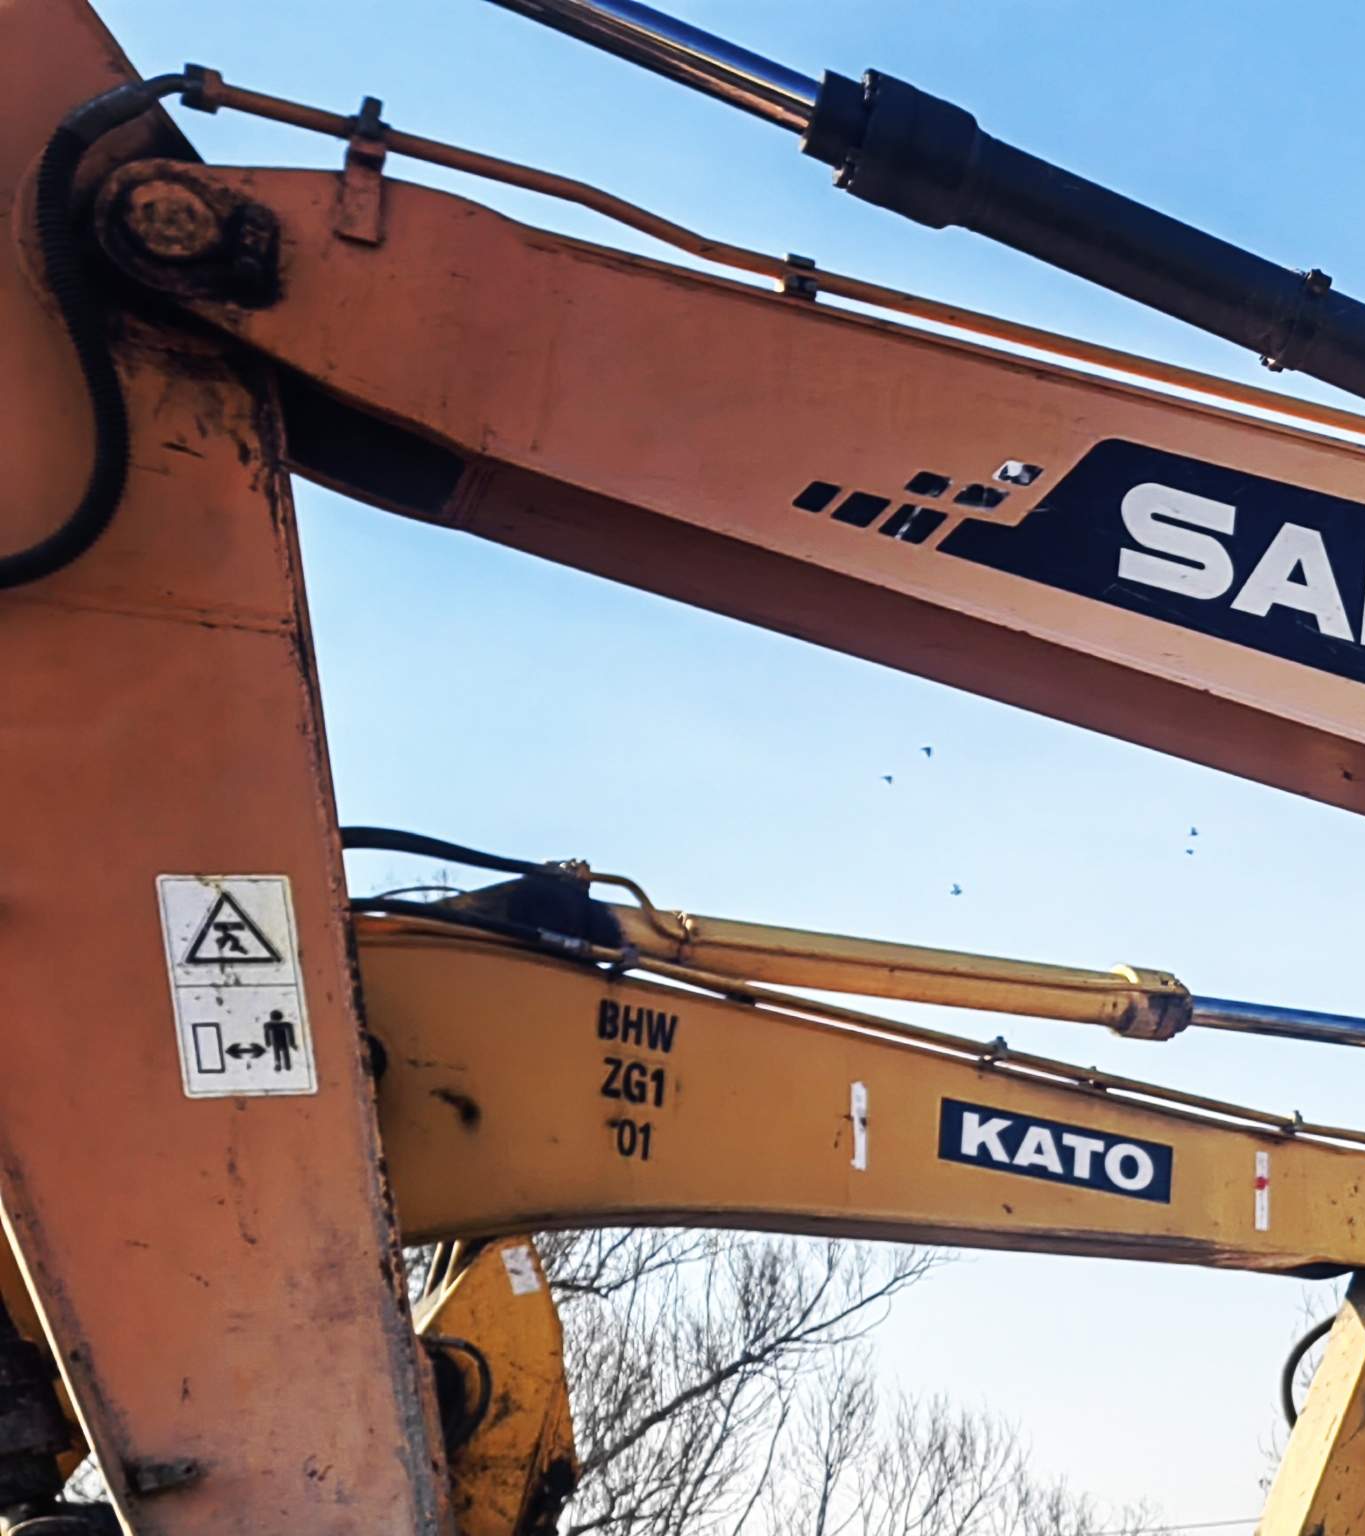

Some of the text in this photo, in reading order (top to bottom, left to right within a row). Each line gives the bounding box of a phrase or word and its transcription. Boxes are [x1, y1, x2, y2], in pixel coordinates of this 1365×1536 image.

[598, 998, 678, 1053] BHW
[601, 1057, 665, 1107] ZG1
[960, 1111, 1154, 1191] KATO
